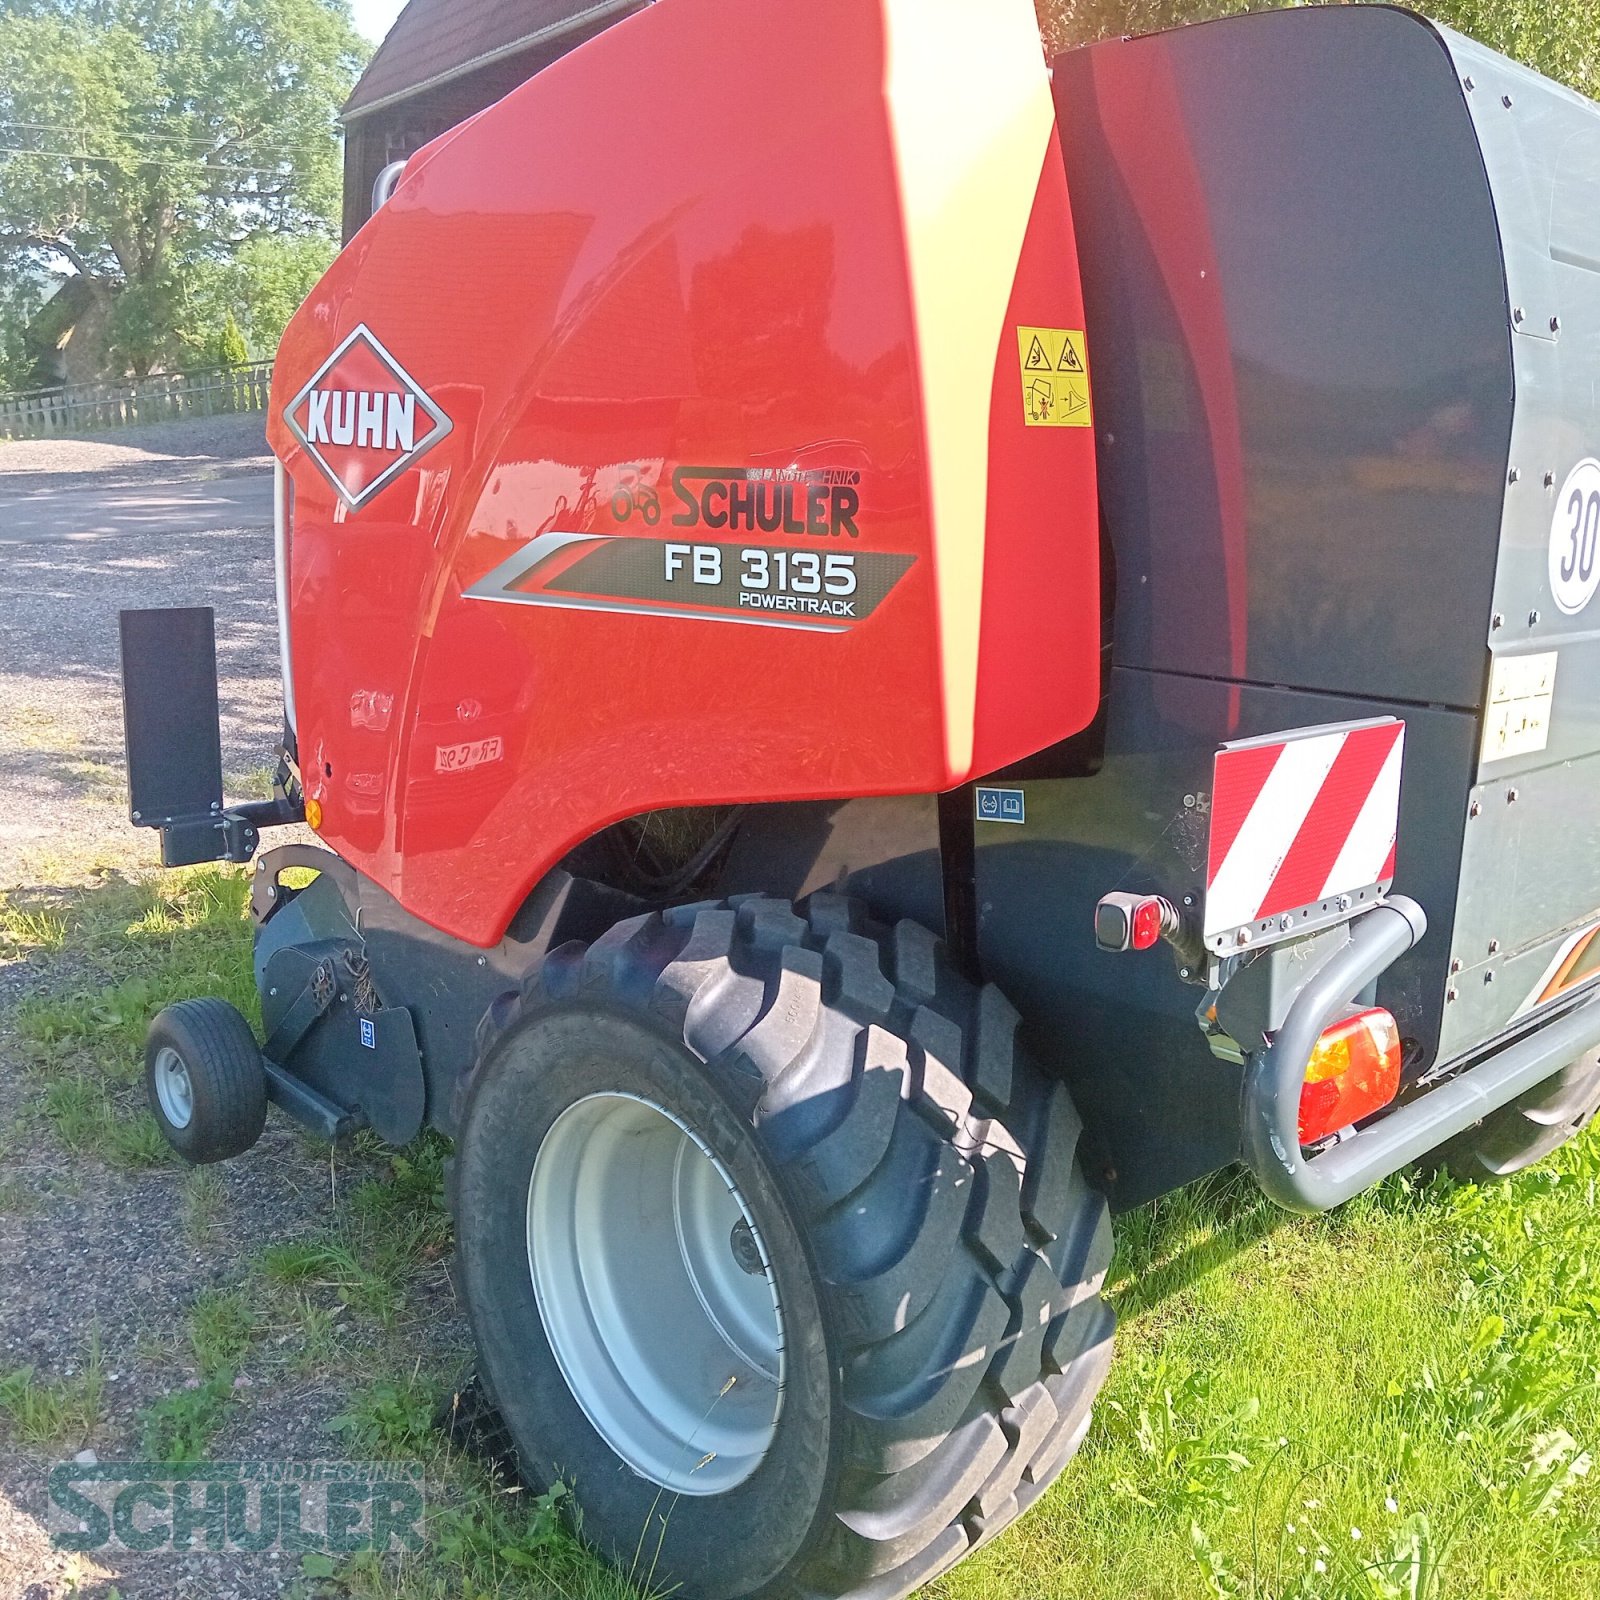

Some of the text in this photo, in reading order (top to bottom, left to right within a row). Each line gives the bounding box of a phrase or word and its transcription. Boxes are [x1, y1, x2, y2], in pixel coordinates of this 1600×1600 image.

[307, 389, 415, 452] KUHN
[672, 466, 860, 538] SCHULER
[1561, 488, 1600, 582] 30
[665, 543, 857, 596] FB 3135
[739, 592, 856, 617] POWERTRACK
